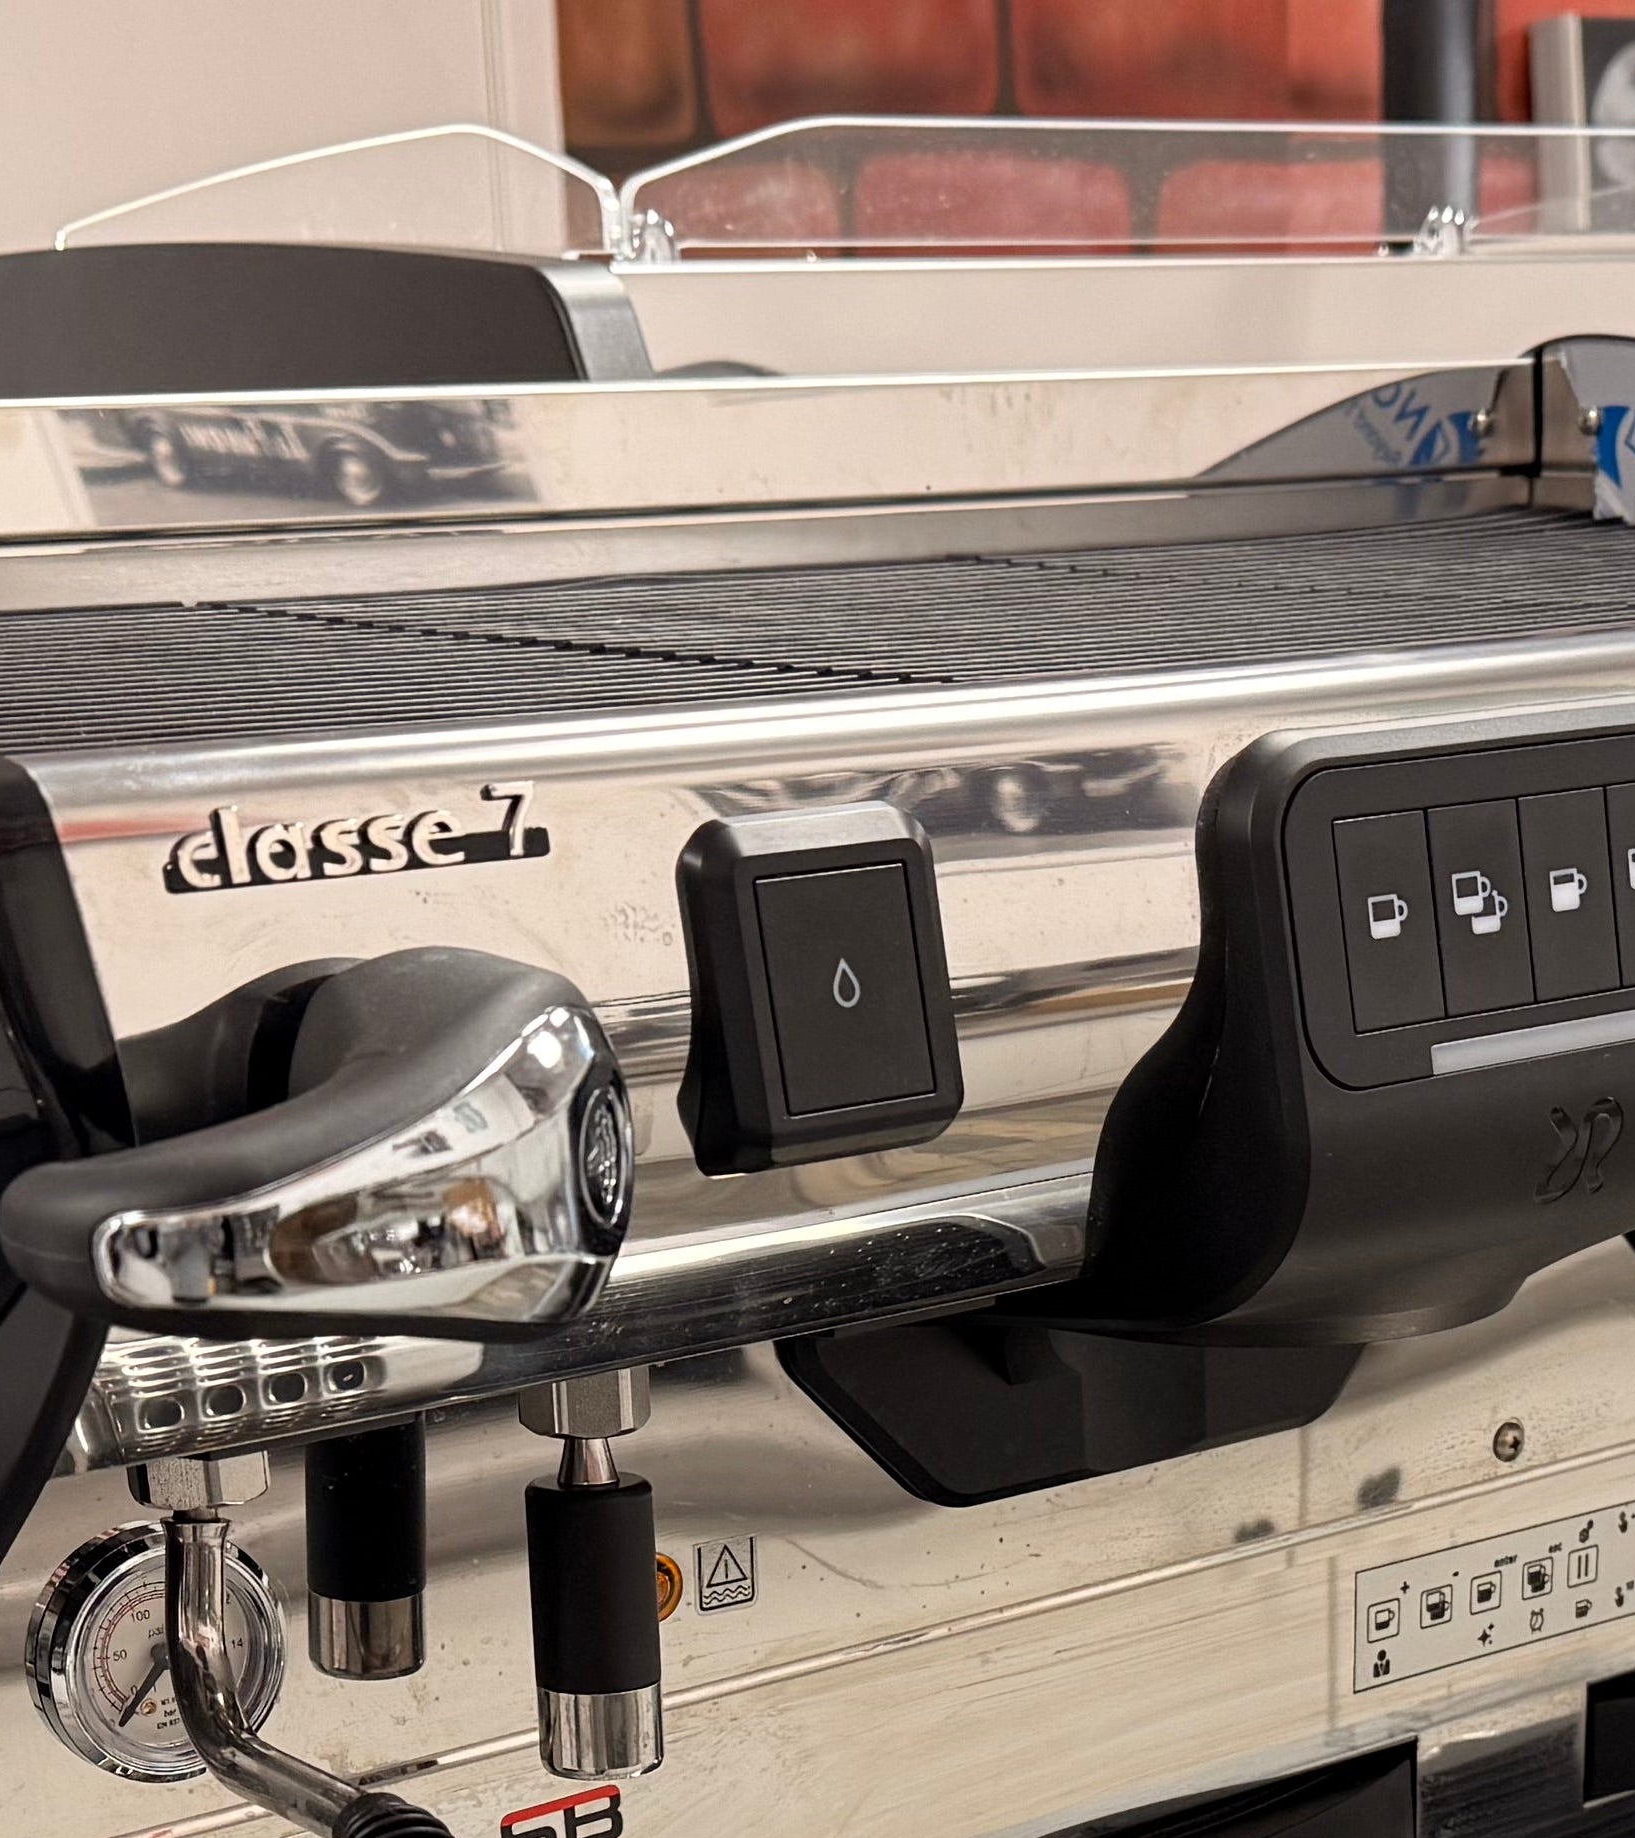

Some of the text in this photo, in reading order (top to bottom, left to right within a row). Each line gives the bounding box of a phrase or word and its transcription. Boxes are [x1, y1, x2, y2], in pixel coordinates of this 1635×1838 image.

[167, 780, 534, 890] classe 7
[130, 1609, 151, 1623] 100
[232, 1637, 243, 1649] 14
[112, 1649, 128, 1662] 50
